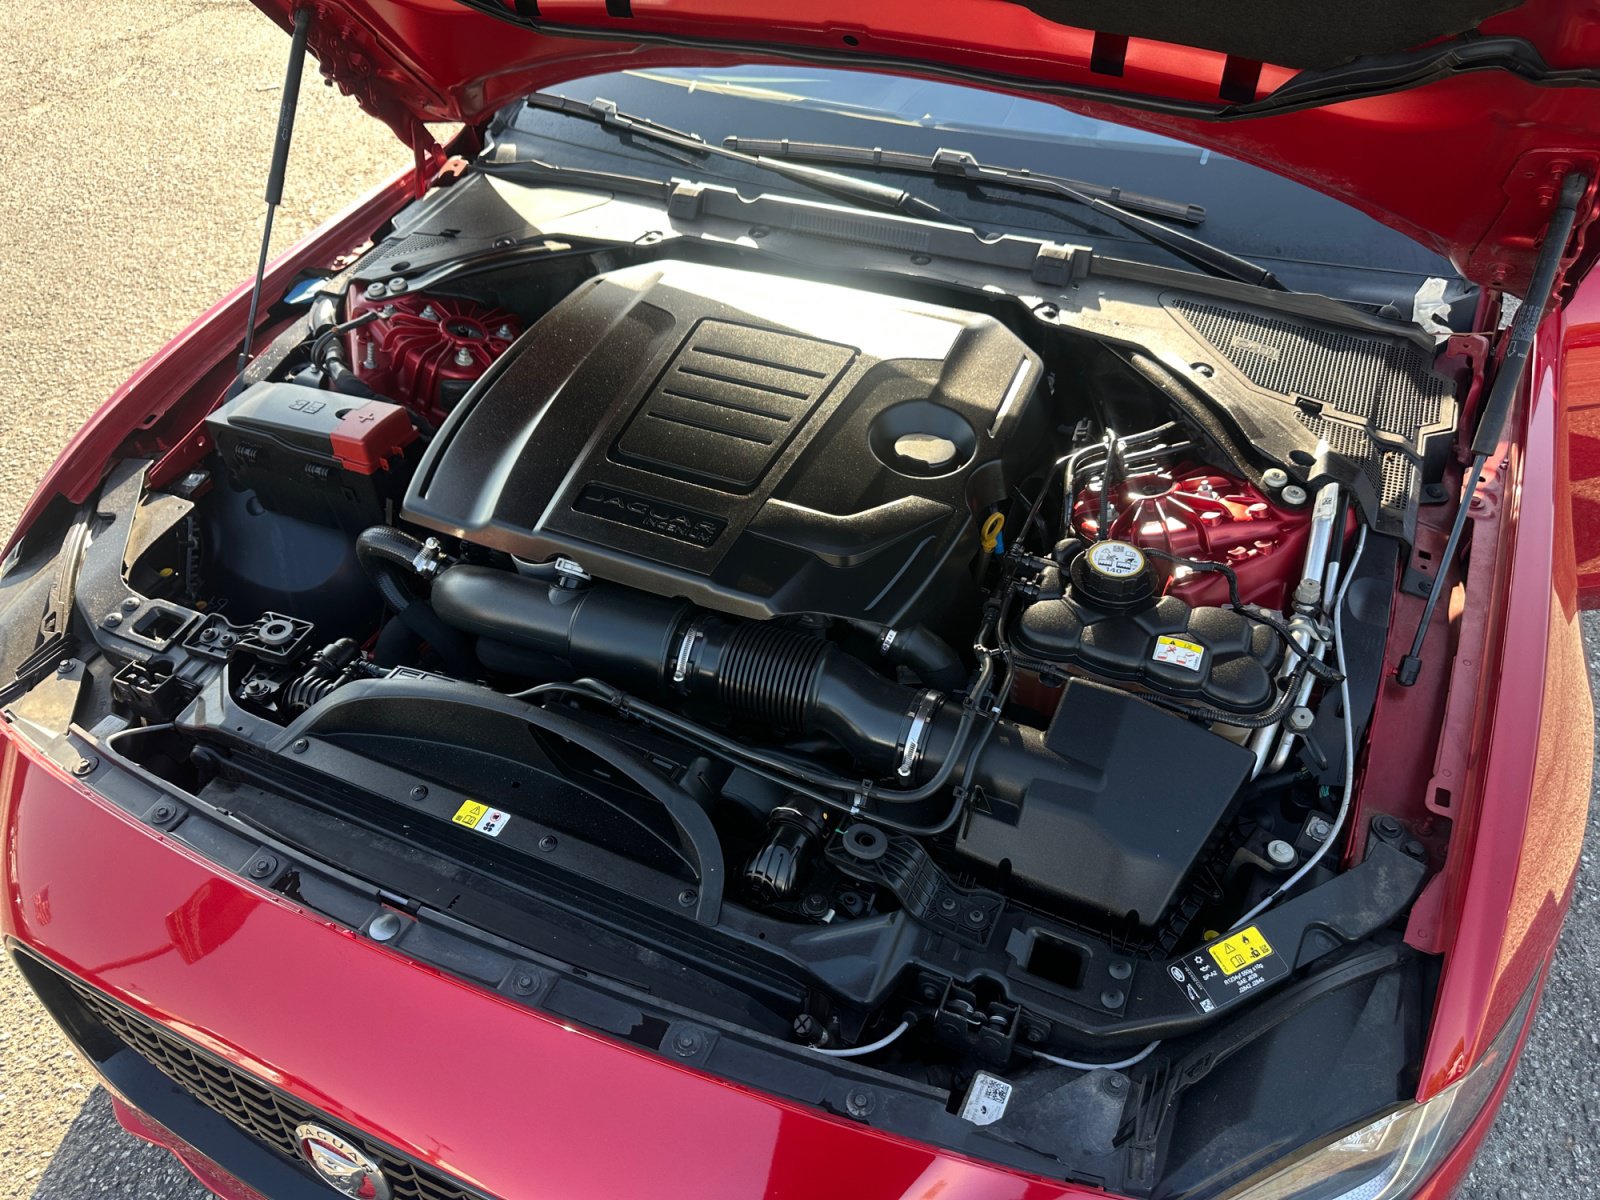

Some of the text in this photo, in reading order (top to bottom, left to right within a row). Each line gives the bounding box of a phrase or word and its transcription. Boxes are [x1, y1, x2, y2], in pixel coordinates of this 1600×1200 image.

[585, 495, 717, 534] JAGUAR
[642, 518, 711, 543] INGENIUM
[299, 1128, 373, 1173] JAGUAR
